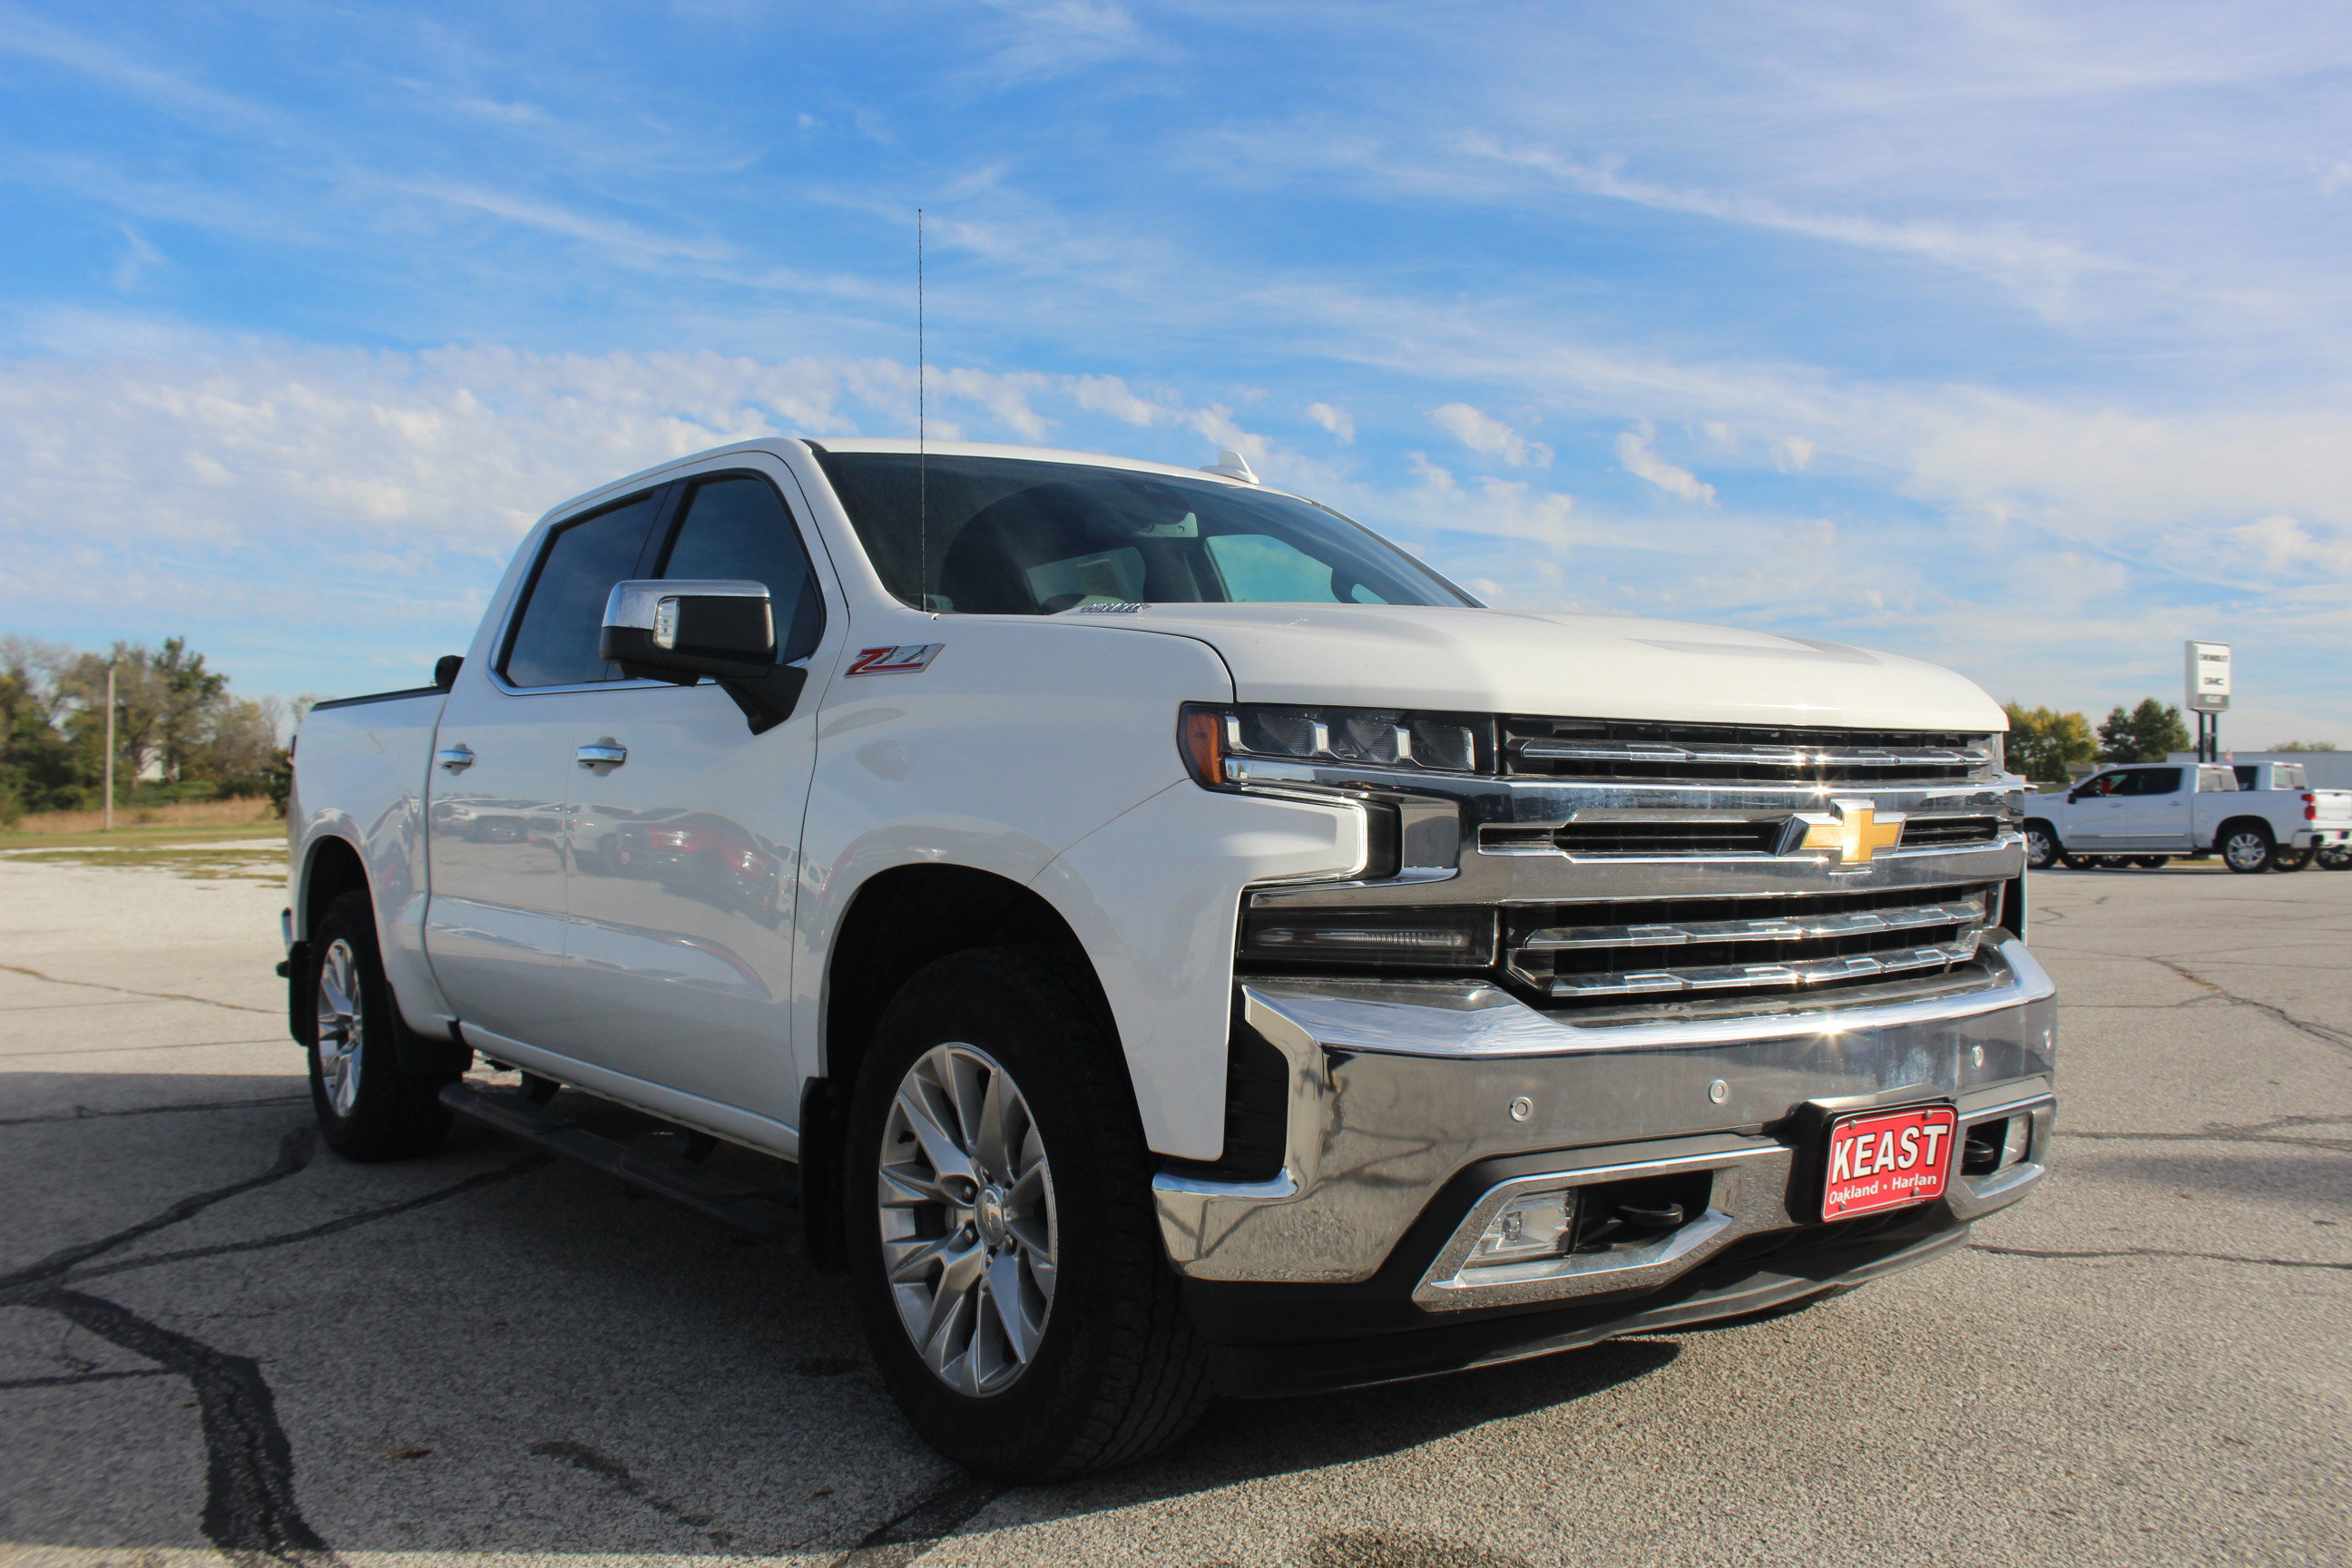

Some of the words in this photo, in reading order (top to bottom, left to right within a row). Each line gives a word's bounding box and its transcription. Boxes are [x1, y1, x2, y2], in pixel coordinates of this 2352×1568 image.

[844, 643, 946, 678] Z71
[1831, 1124, 1948, 1184] KEAST
[1828, 1181, 1878, 1205] Oakland
[1892, 1173, 1937, 1191] Harlan
